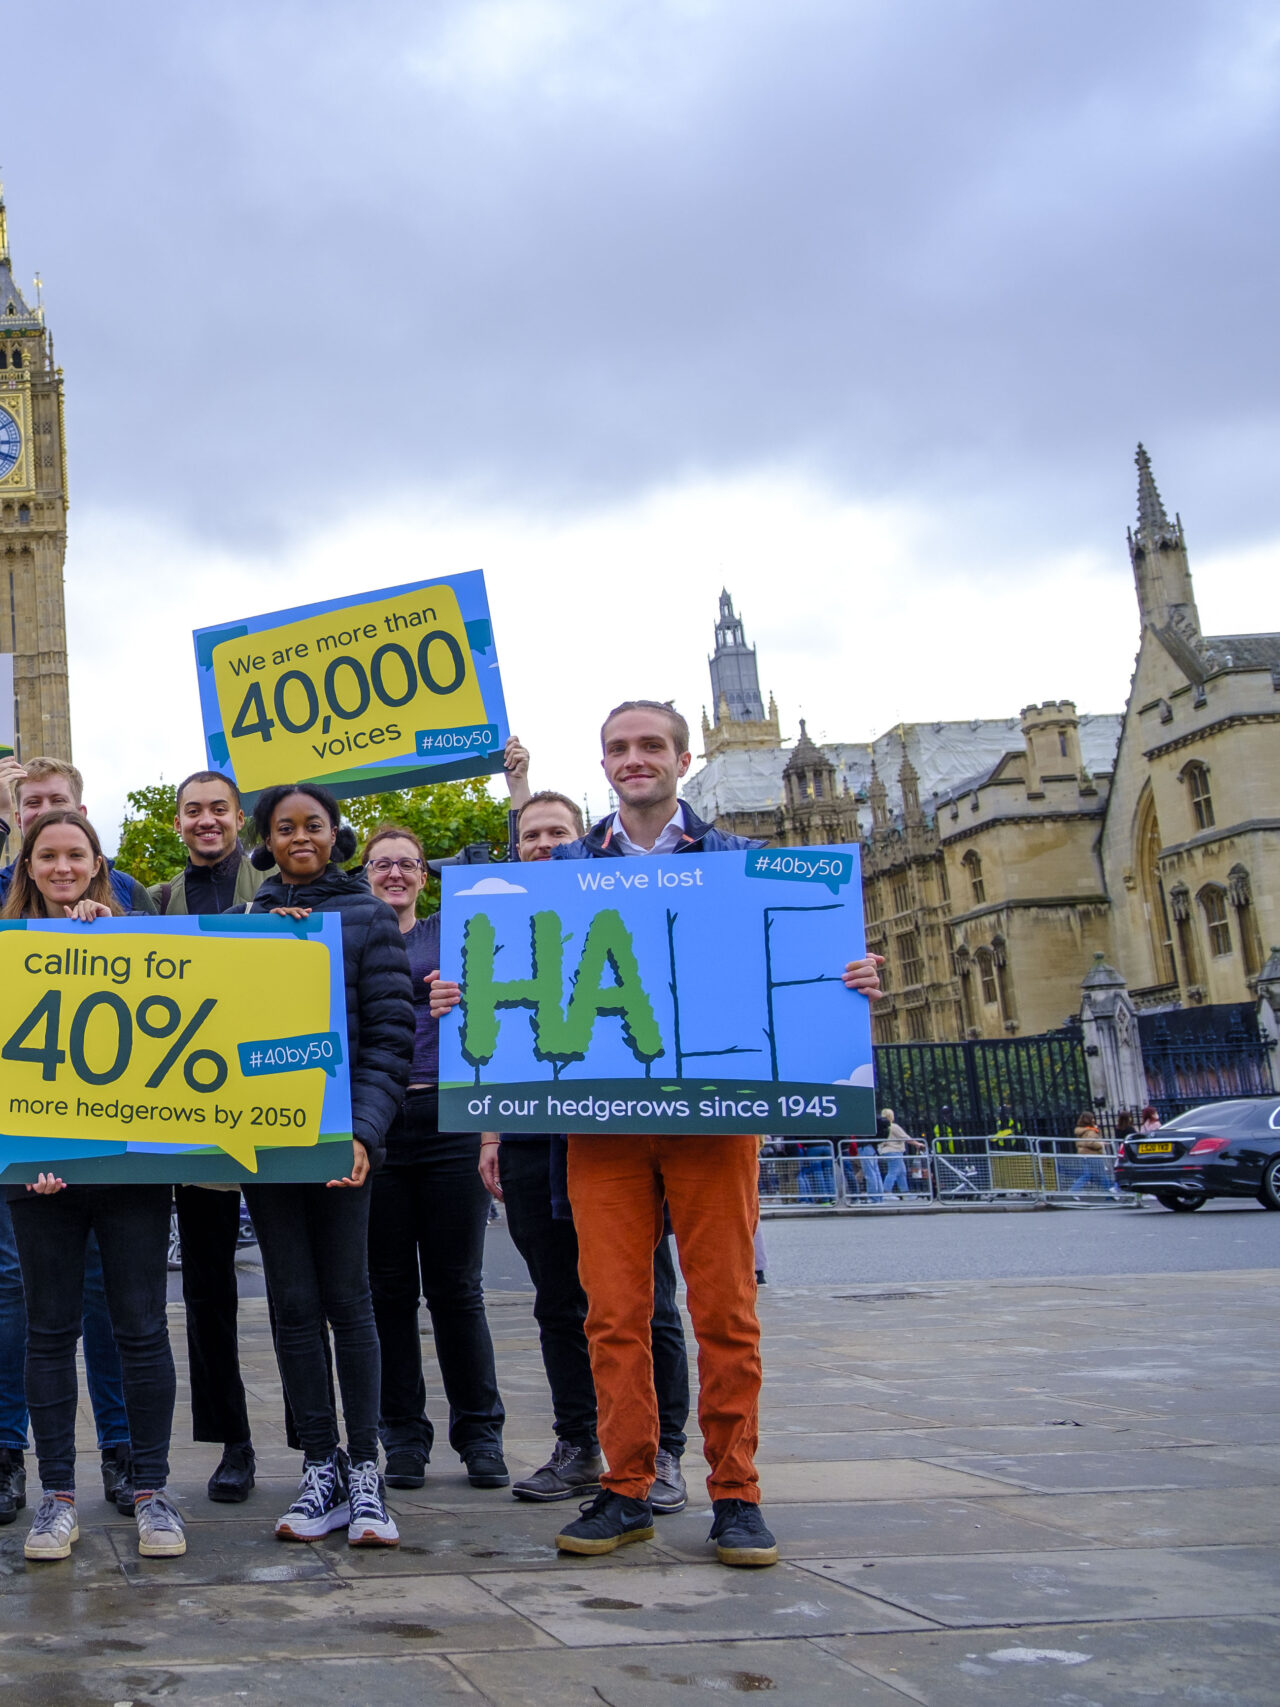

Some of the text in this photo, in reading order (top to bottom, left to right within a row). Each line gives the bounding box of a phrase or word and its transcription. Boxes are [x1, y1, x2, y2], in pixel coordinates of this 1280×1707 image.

[228, 606, 437, 677] We are more than
[231, 629, 466, 743] 40,000
[312, 723, 402, 759] voices
[422, 729, 492, 750] #40by50
[657, 867, 704, 889] lost
[754, 855, 843, 878] #40by50
[23, 948, 191, 985] calling for
[458, 904, 845, 1087] HALF
[1, 989, 228, 1094] 40%
[249, 1040, 333, 1069] #40by50
[9, 1097, 307, 1130] more hedgerows by 2050
[467, 1094, 838, 1123] of our hedgerows since 1945
